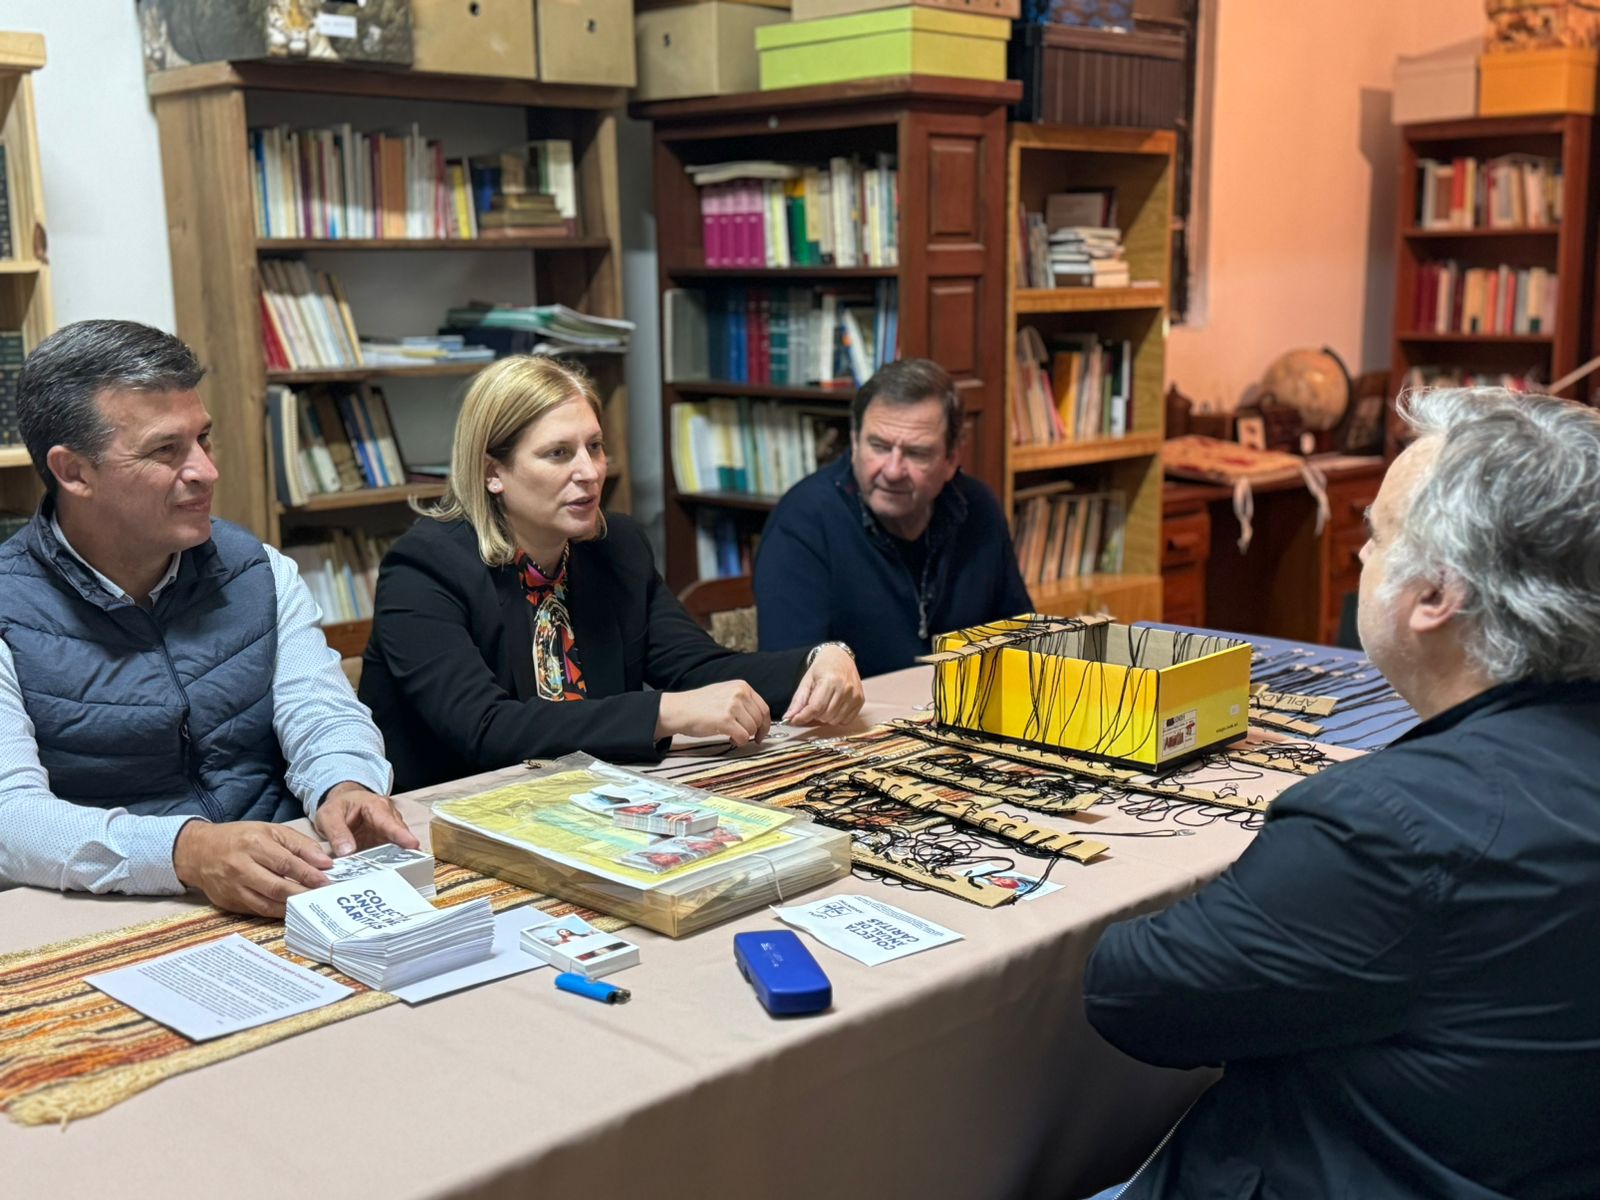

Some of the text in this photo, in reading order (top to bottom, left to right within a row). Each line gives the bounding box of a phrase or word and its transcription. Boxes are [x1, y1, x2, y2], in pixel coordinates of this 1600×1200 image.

[350, 893, 385, 920] ANUAL
[844, 924, 896, 951] COLECTA
[854, 920, 908, 946] ANUAL DE
